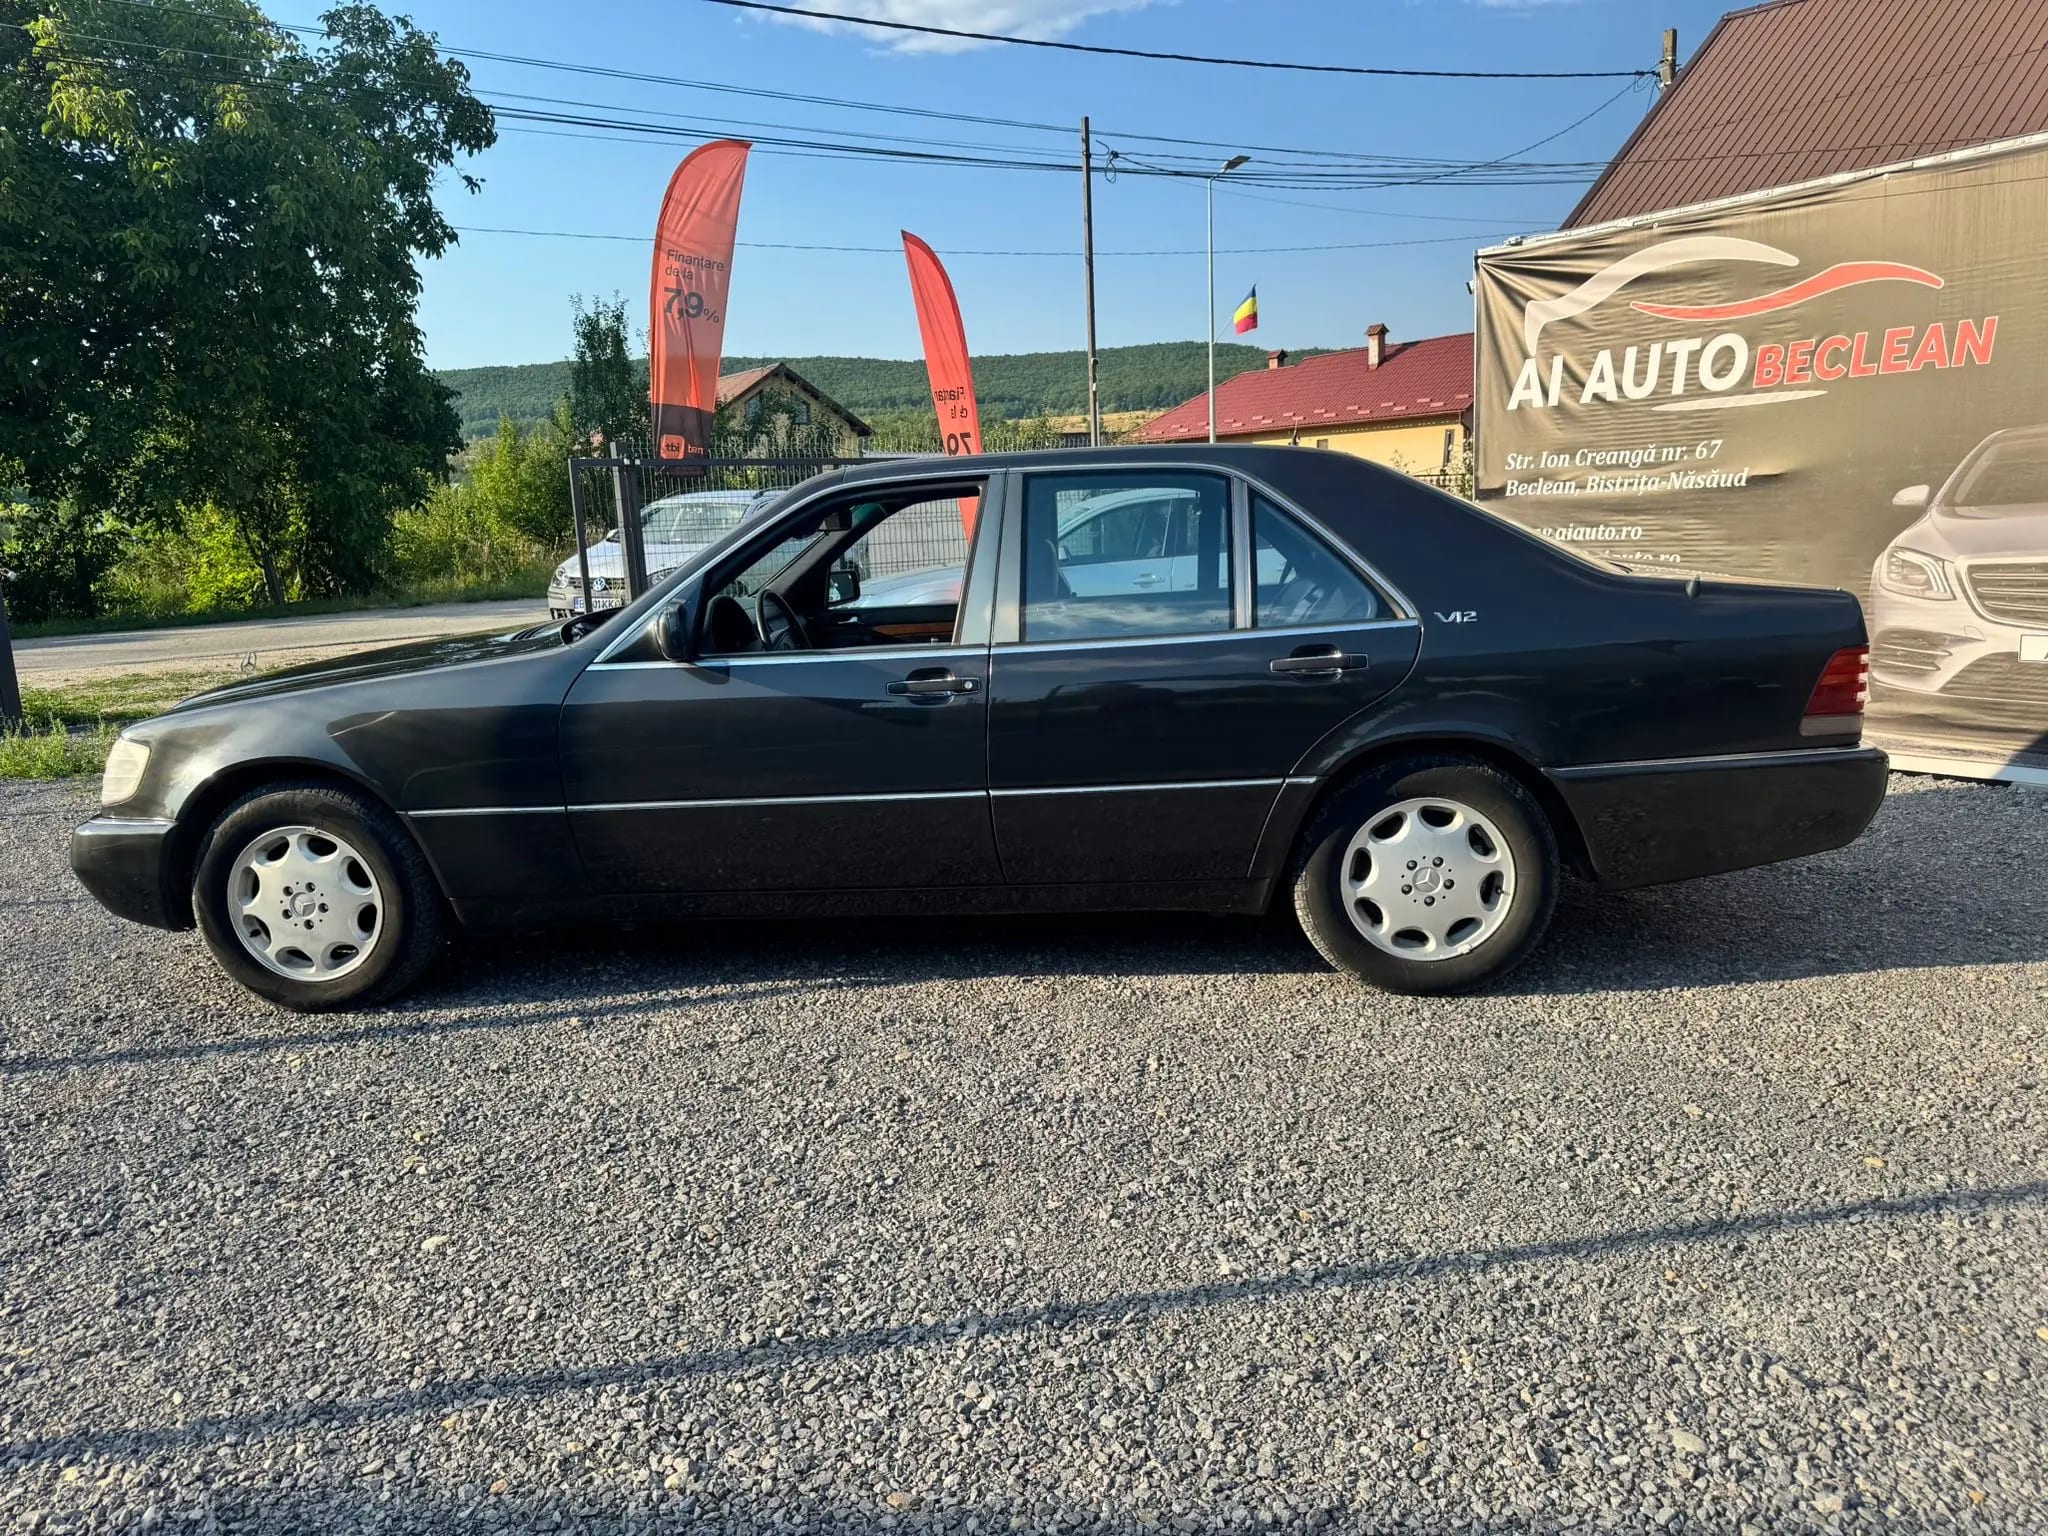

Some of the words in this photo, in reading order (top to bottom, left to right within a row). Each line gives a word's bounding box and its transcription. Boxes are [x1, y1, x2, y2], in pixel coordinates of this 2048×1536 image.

[665, 265, 679, 277] de
[683, 268, 693, 280] la
[1507, 355, 1563, 411] AI
[1580, 333, 1749, 404] AUTO
[1752, 316, 1998, 388] BECLEAN
[665, 443, 680, 453] tbi
[1505, 452, 1534, 470] Str.
[1539, 451, 1570, 469] Ion
[1575, 444, 1657, 468] Creangă
[1661, 446, 1688, 461] nr.
[1695, 440, 1723, 459] 67
[1505, 478, 1579, 497] Beclean,
[1585, 467, 1749, 495] Bistrița-Năsăud
[1433, 611, 1477, 622] V12
